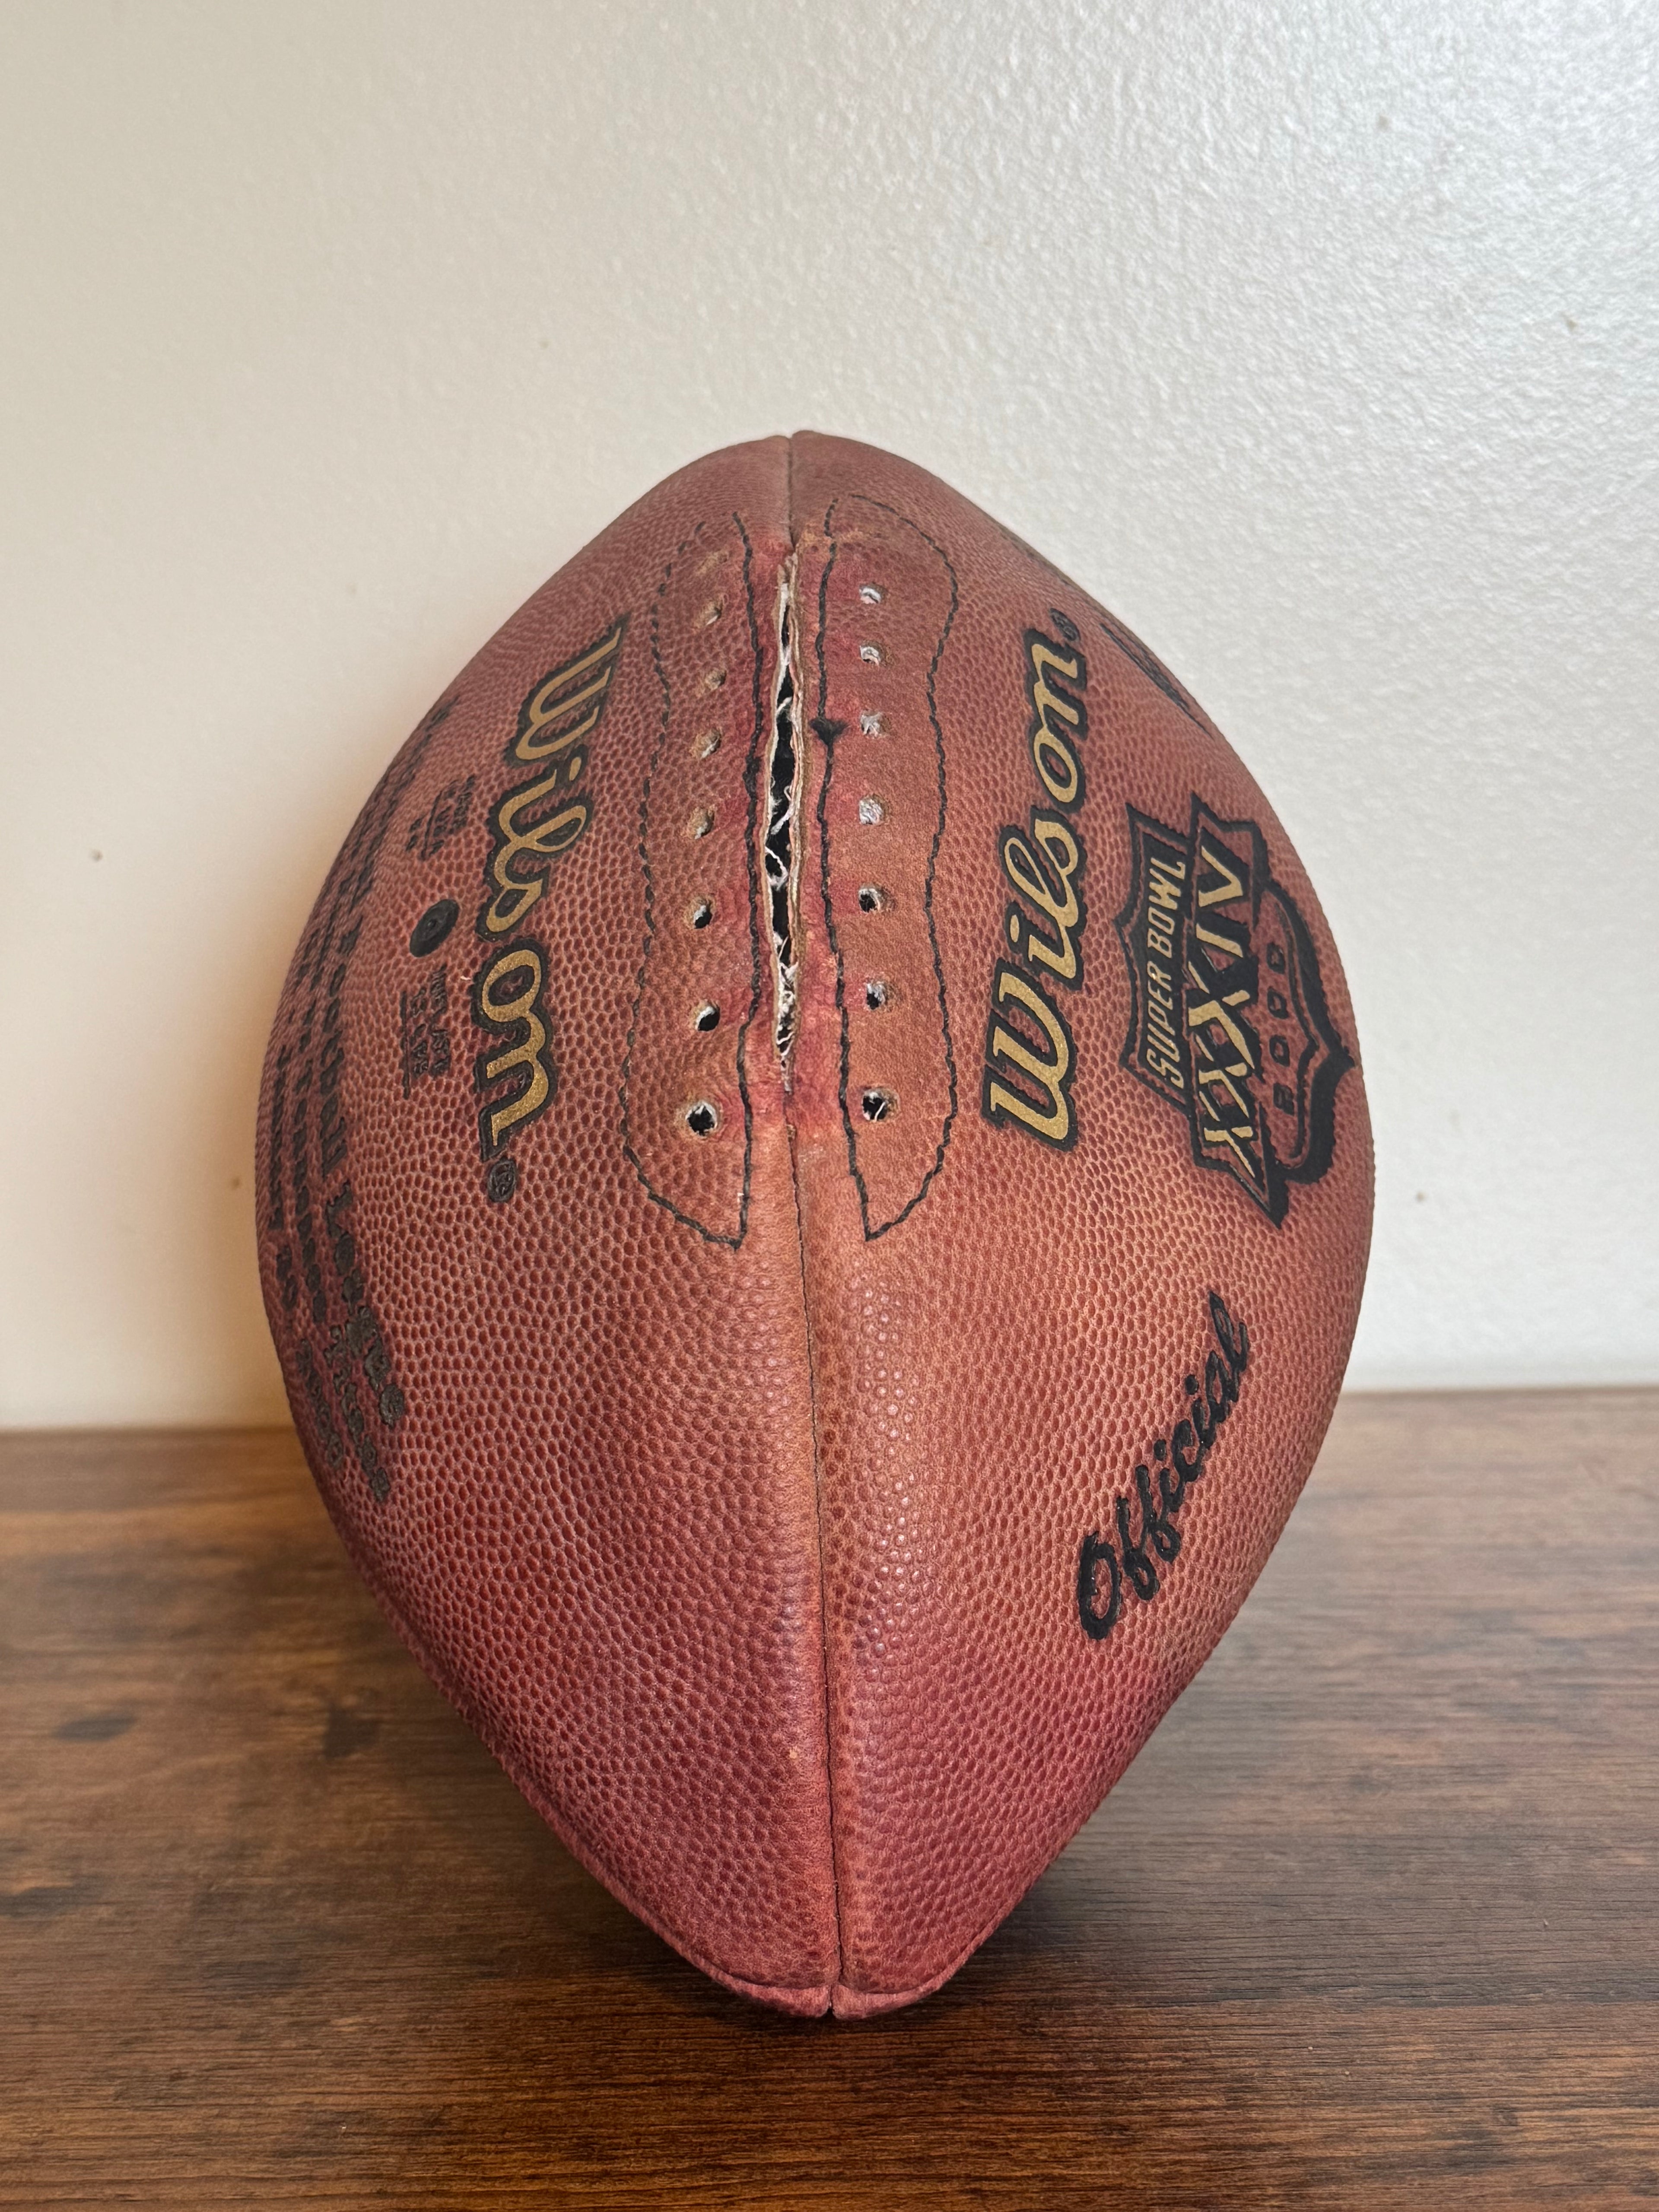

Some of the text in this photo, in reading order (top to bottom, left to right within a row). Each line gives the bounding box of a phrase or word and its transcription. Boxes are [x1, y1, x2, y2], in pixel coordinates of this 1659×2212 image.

[472, 611, 630, 1162] Wilson
[981, 626, 1089, 1153] Wilson
[1145, 856, 1186, 1090] SUPER BOWL
[1187, 842, 1256, 1180] XXXIV
[1266, 941, 1297, 1116] 2000
[319, 913, 364, 1179] Football
[325, 1181, 405, 1428] League
[1076, 1290, 1252, 1642] Official
